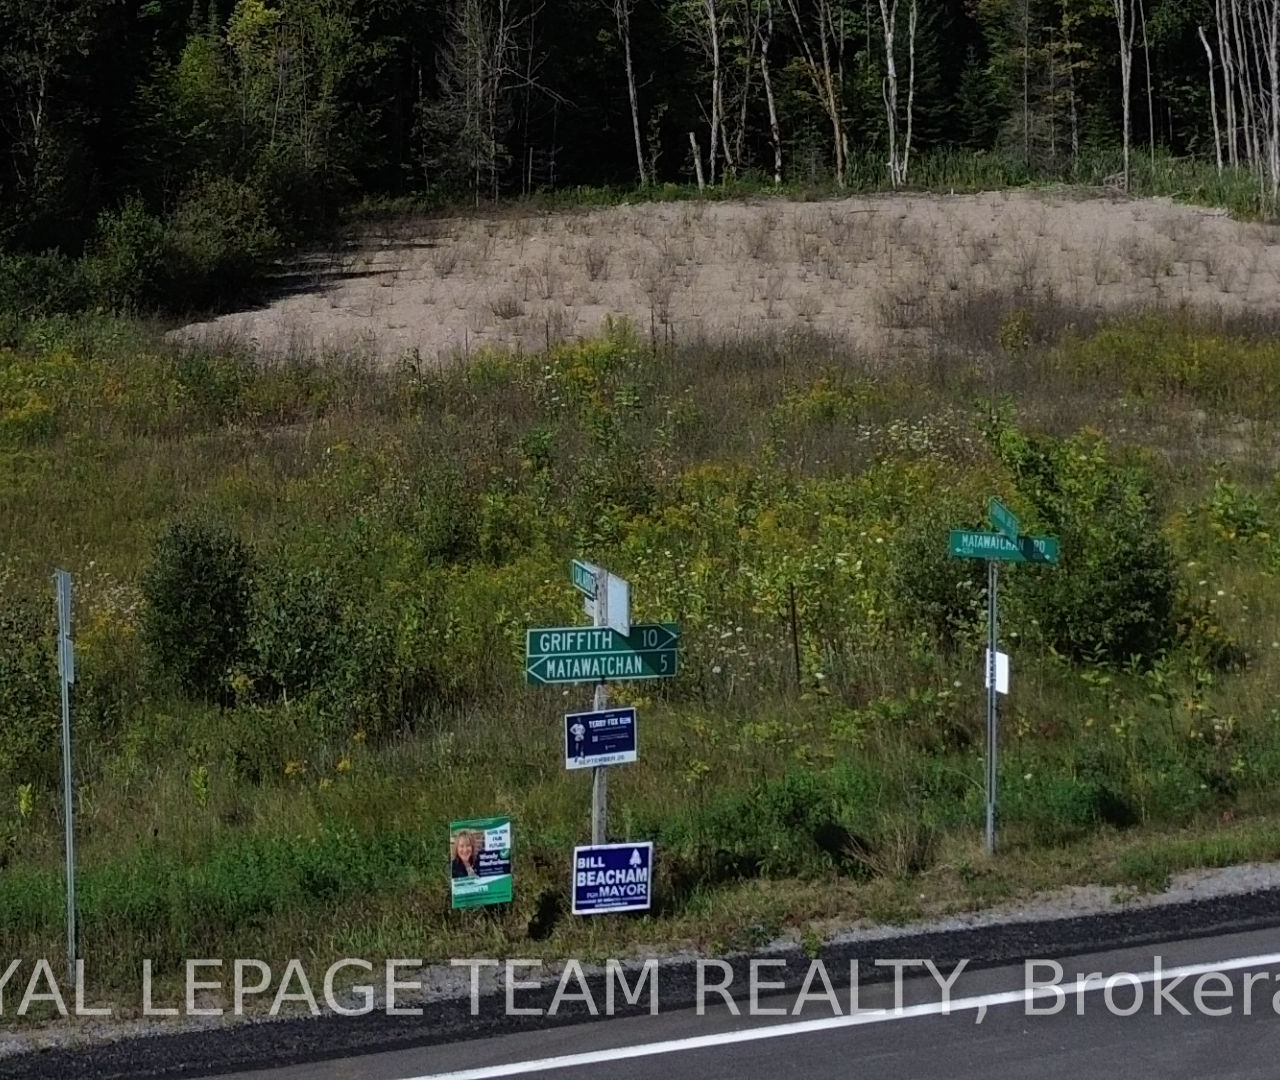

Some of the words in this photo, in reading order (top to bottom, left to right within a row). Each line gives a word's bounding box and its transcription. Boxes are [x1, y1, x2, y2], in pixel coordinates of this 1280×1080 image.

[1033, 540, 1045, 553] RD
[540, 630, 613, 652] GRIFFITH
[642, 629, 658, 648] 10
[546, 655, 642, 679] MATAWATCHAN
[660, 654, 668, 673] 5
[577, 856, 606, 869] BILL
[576, 867, 648, 887] BEACHAM
[599, 883, 647, 897] MAYOR
